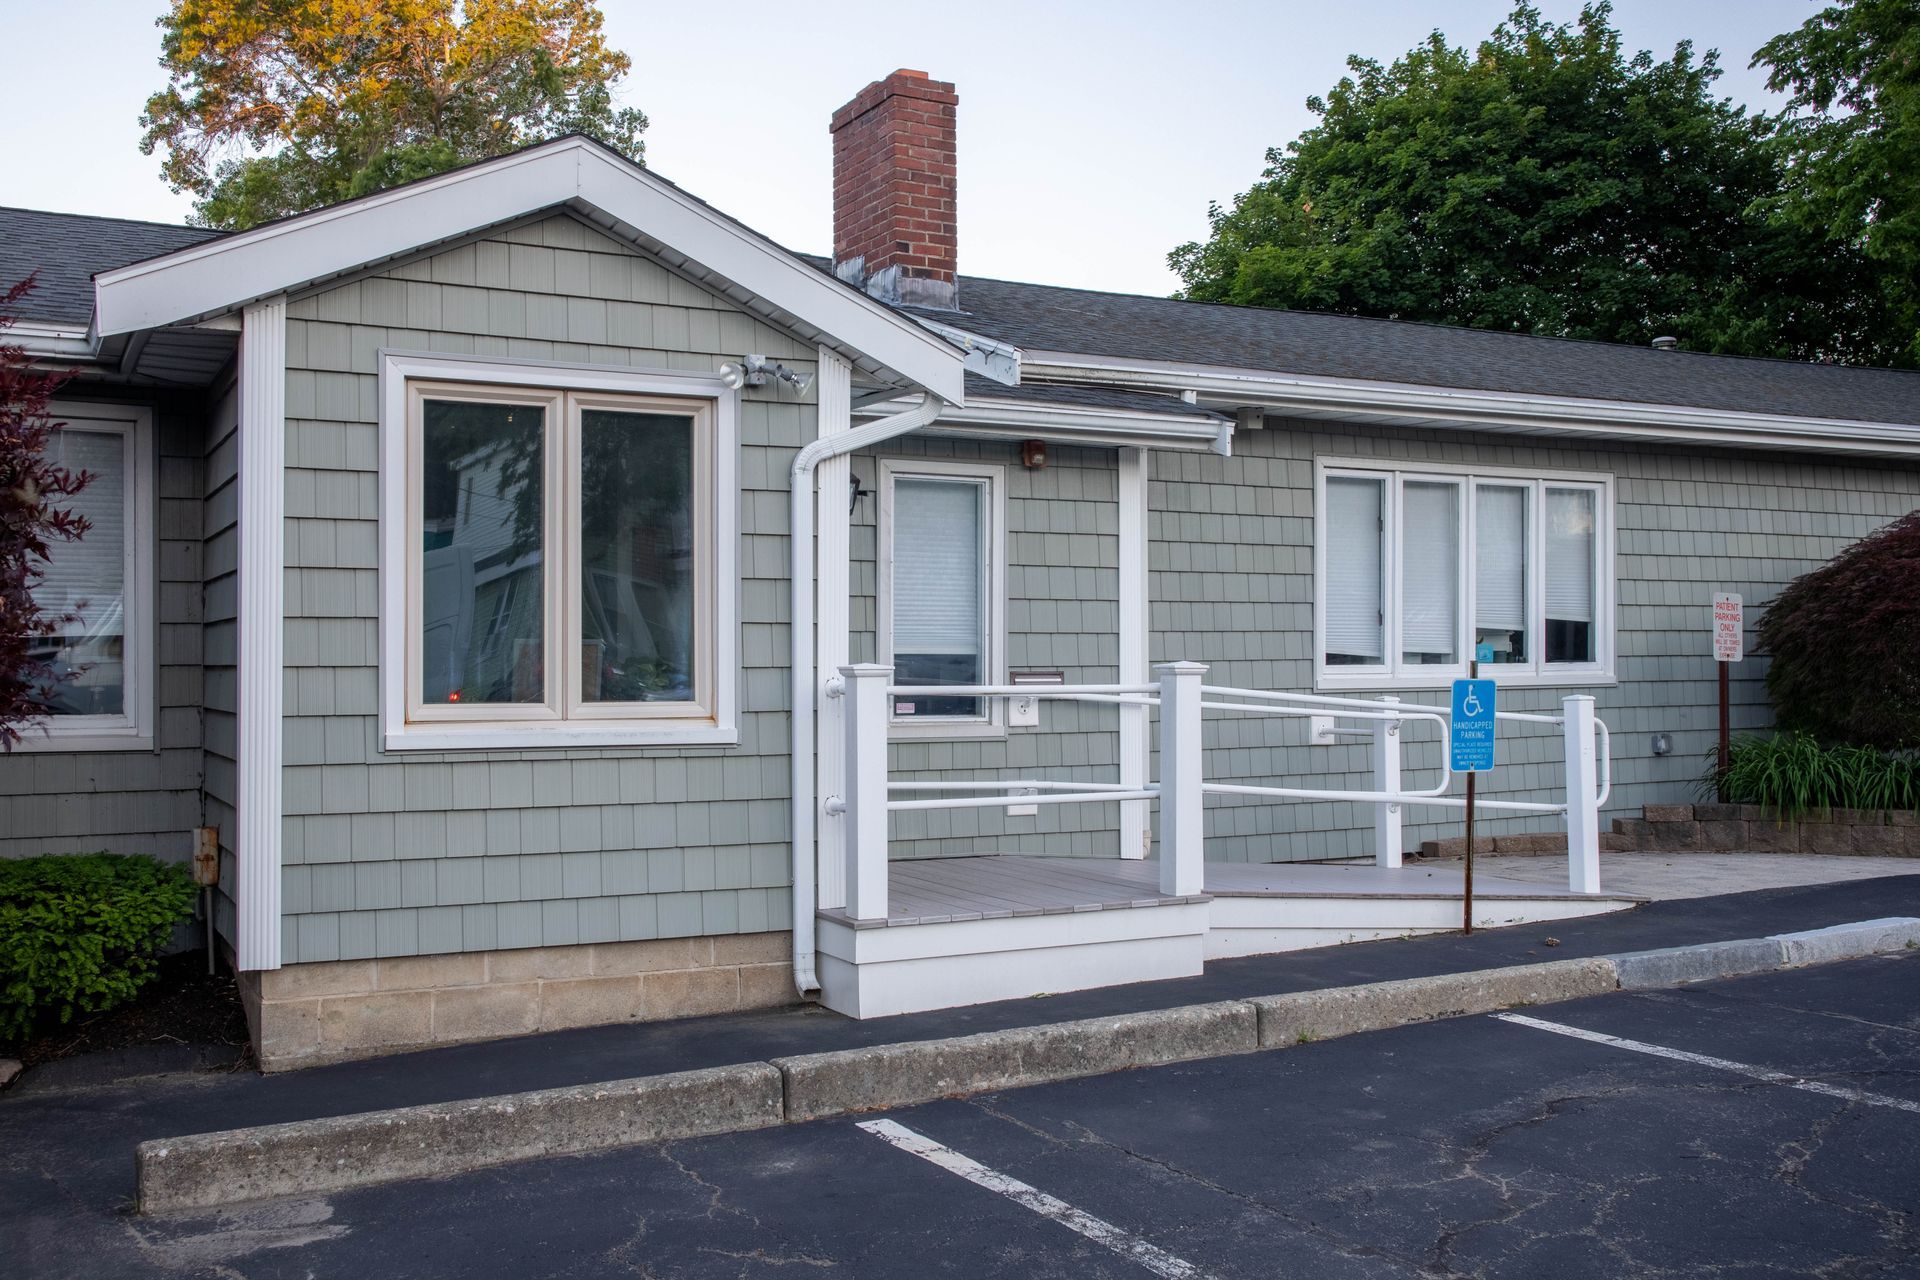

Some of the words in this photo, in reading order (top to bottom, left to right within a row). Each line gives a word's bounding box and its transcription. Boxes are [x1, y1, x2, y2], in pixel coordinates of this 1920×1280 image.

[1716, 602, 1740, 611] PATIENT
[1715, 612, 1740, 622] PARKING
[1720, 623, 1735, 632] ONLY
[1453, 721, 1493, 729] HANDICAPPED
[1460, 731, 1485, 739] PARKING
